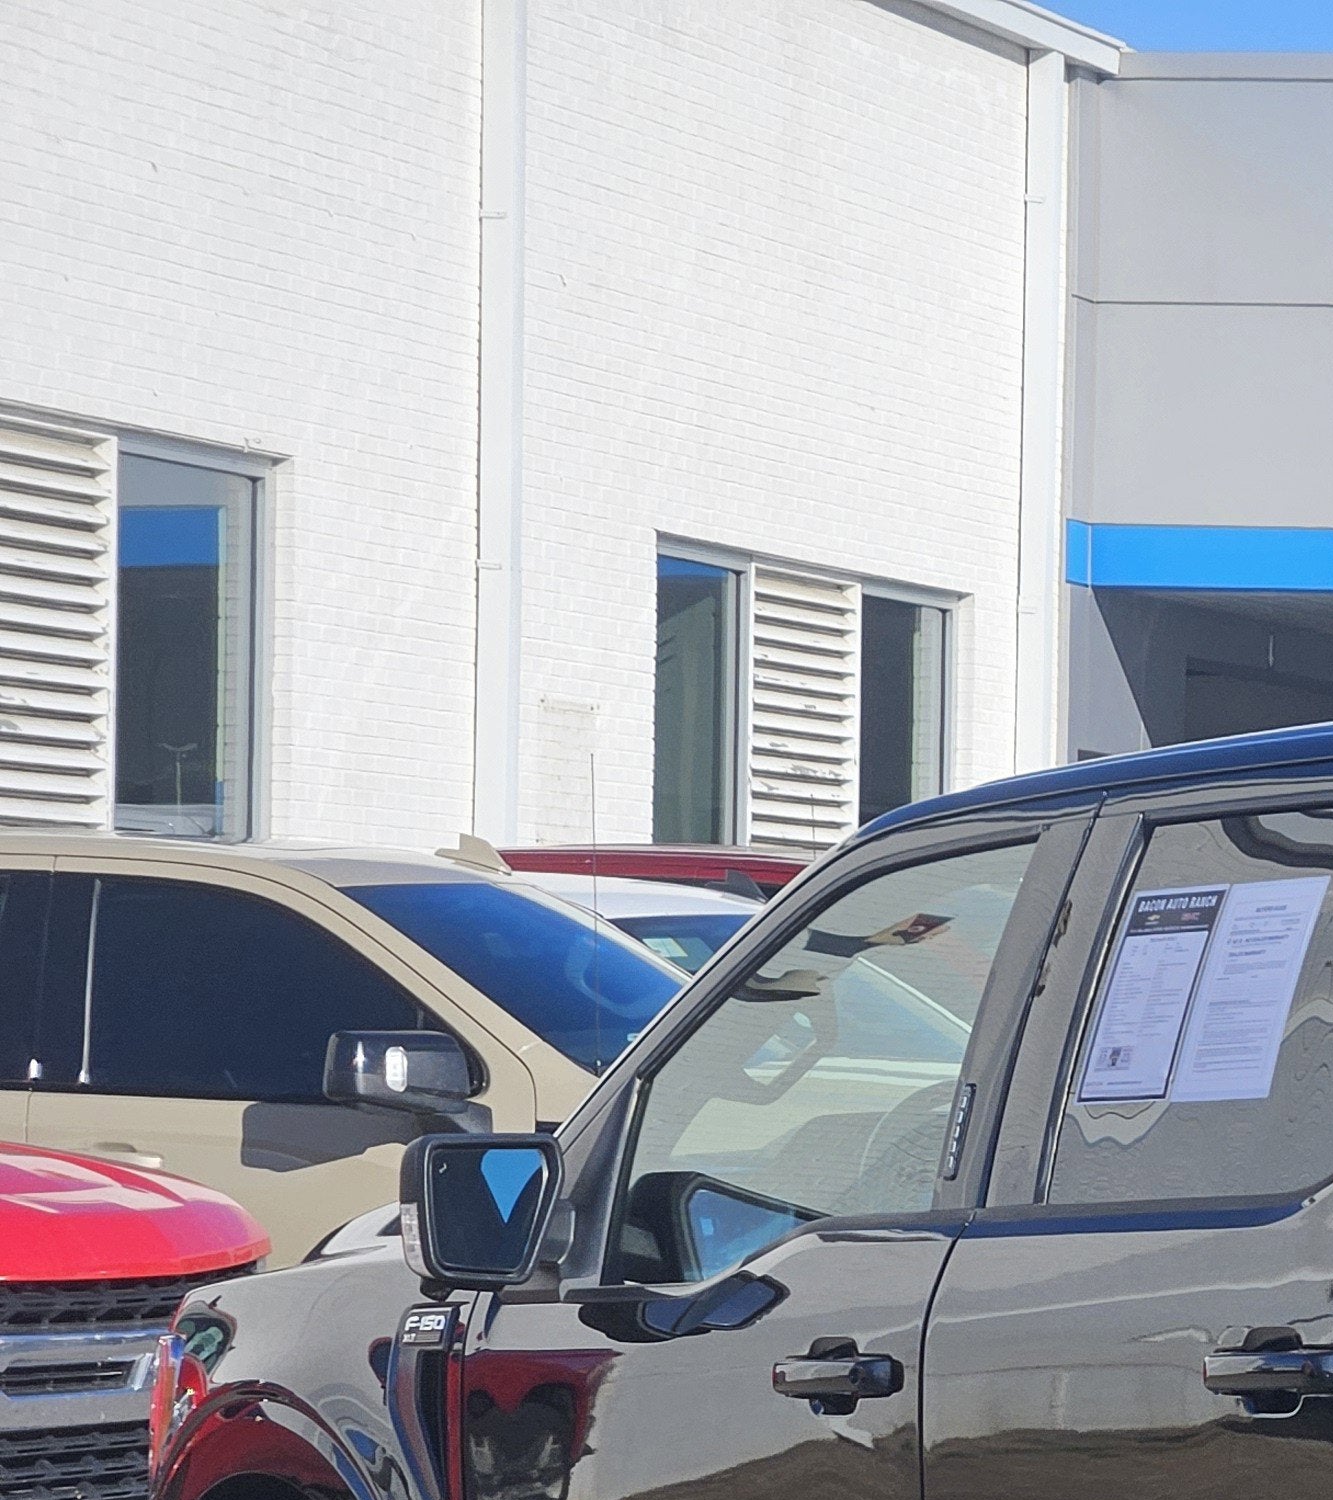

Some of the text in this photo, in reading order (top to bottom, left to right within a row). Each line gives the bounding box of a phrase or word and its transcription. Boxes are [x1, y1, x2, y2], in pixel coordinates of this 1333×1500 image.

[1138, 895, 1218, 913] BACON AUTO RANCH
[404, 1315, 446, 1331] F-150
